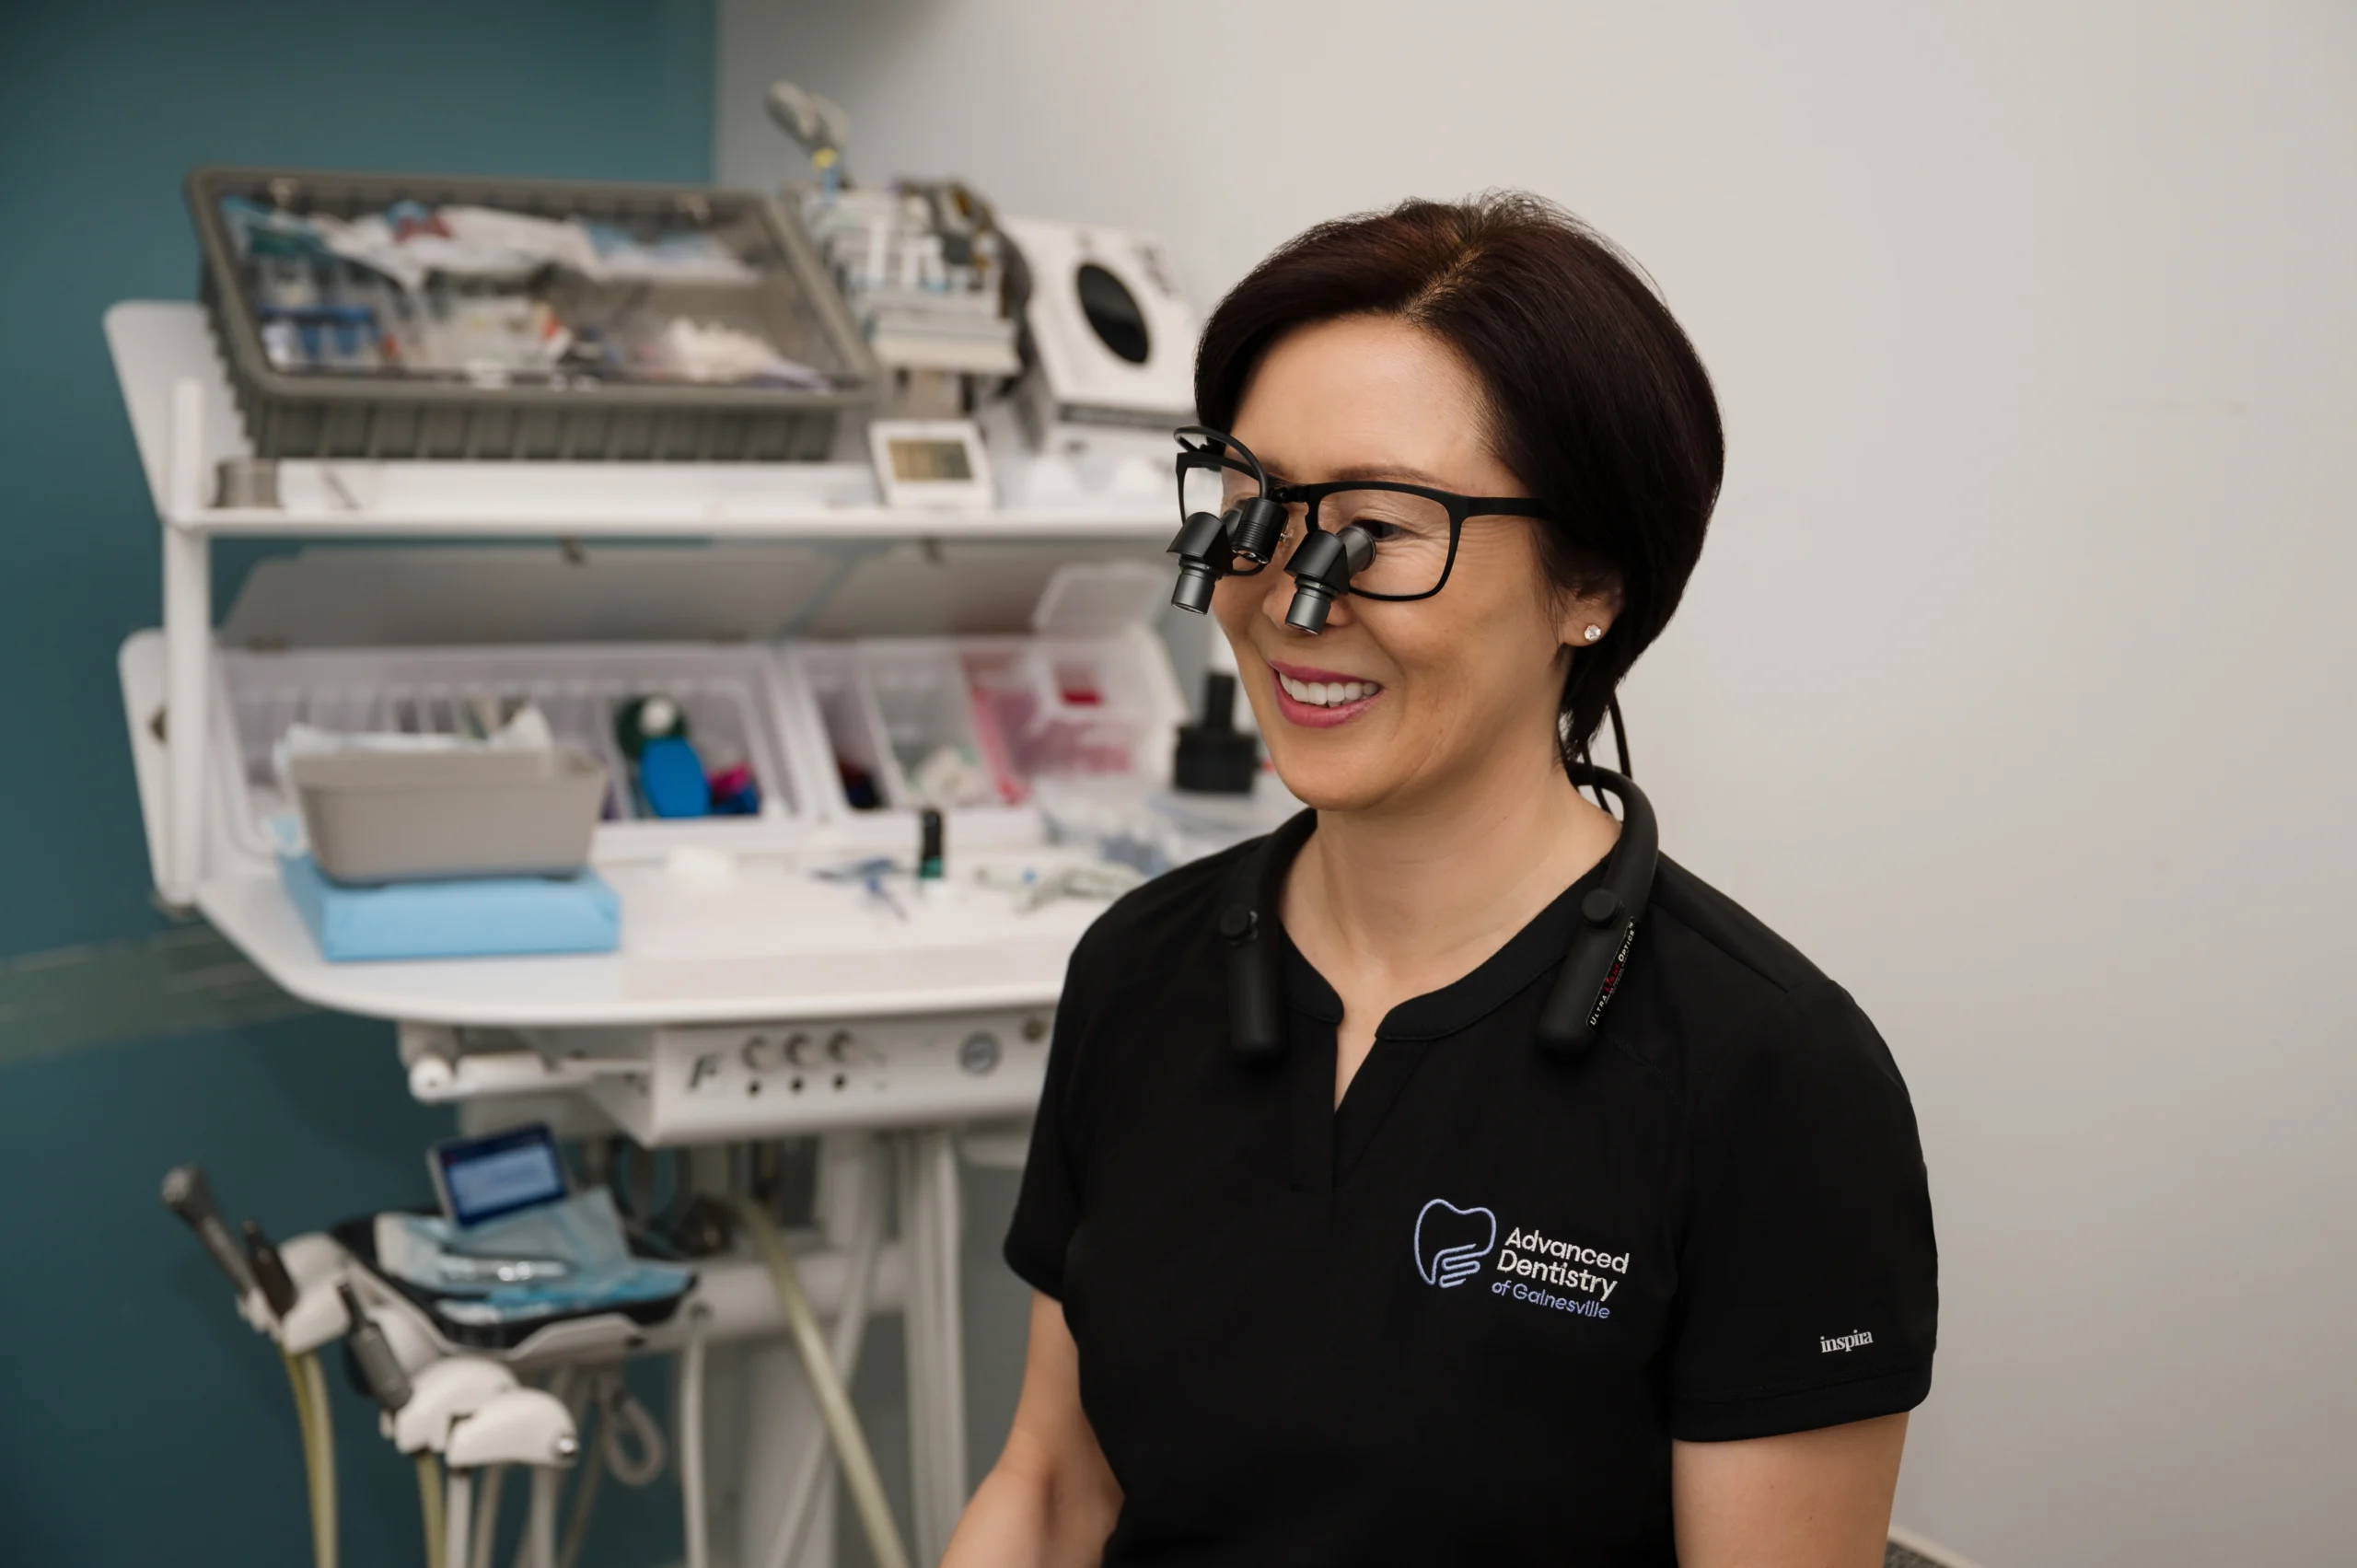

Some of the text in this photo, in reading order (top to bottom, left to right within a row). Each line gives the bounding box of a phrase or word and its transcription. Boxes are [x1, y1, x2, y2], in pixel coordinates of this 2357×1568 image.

[1504, 1226, 1630, 1274] Advanced
[1496, 1249, 1618, 1302] Dentistry
[1492, 1281, 1610, 1318] of Gainesville
[1820, 1330, 1874, 1353] inspira
